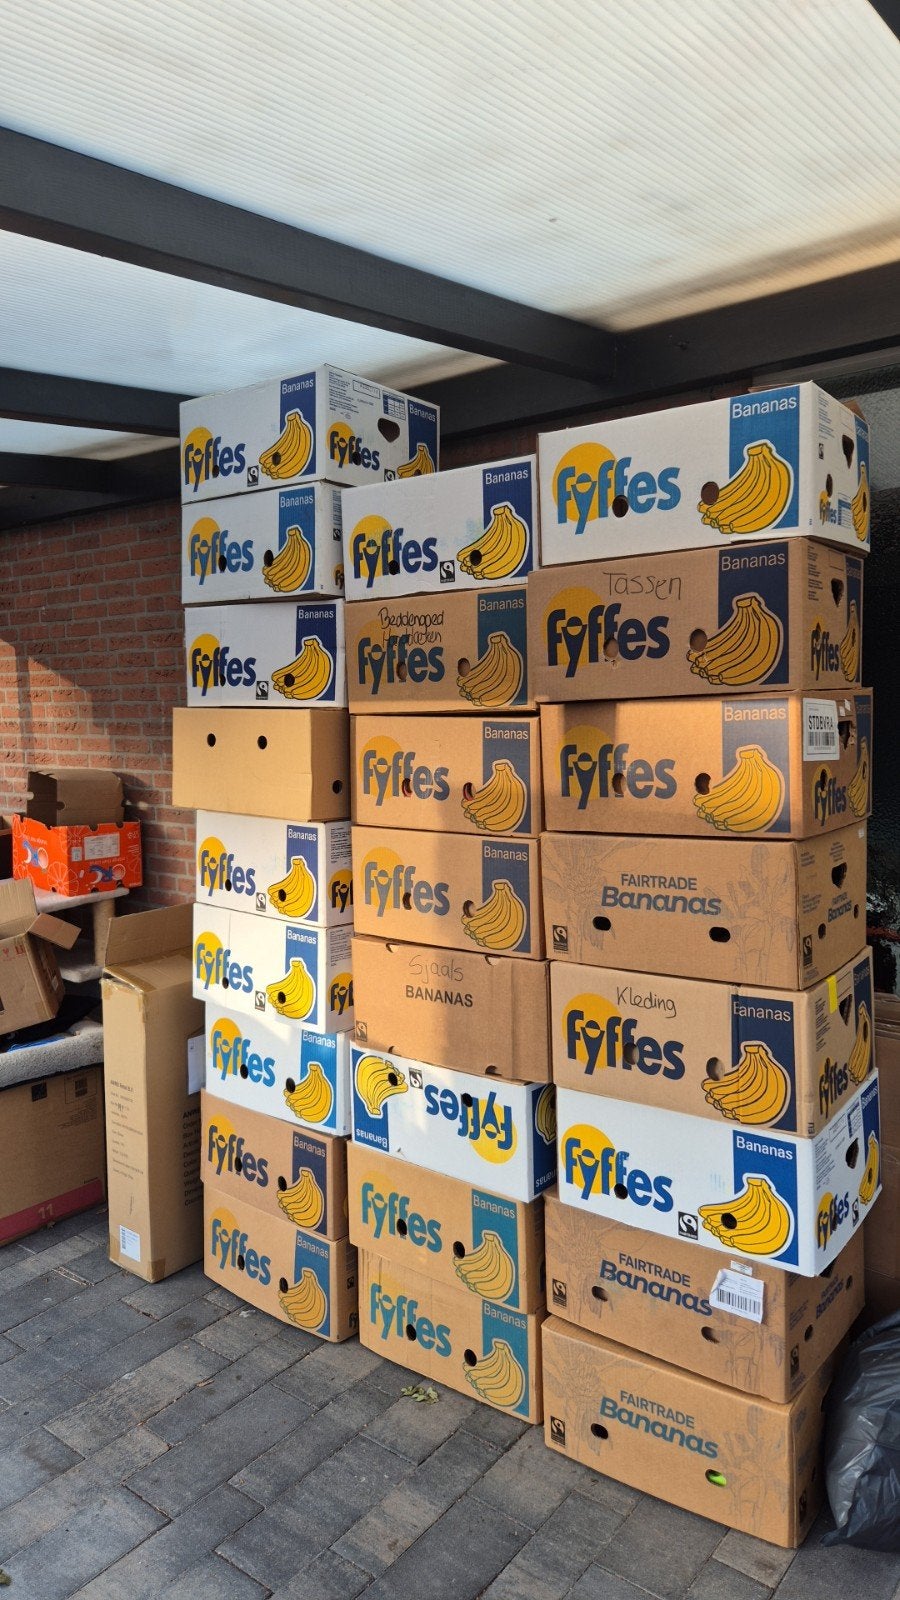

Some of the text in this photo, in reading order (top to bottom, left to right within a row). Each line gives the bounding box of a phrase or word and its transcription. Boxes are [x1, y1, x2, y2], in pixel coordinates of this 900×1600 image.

[282, 379, 314, 394] Bananas
[409, 404, 437, 422] Bananas
[731, 396, 797, 419] Bananas
[485, 469, 529, 485] Bananas
[280, 493, 314, 508] Bananas
[721, 552, 786, 571] Bananas
[603, 571, 682, 600] Tassen
[298, 609, 334, 619] Bananas
[479, 597, 524, 612] Bananas
[724, 706, 787, 722] Bananas
[484, 727, 528, 740] Bananas
[288, 829, 317, 842] Bananas
[483, 846, 528, 861] Bananas
[620, 873, 698, 891] FAIRTRADE
[600, 886, 722, 916] Bananas
[287, 929, 317, 944] Bananas
[408, 954, 464, 984] Sjaals
[405, 985, 473, 1007] BANANAS
[616, 986, 676, 1018] Kleding
[303, 1031, 336, 1048] Bananas
[294, 1136, 326, 1158] Bananas
[355, 1128, 388, 1148] Bananas
[736, 1135, 794, 1161] Bananas
[535, 1169, 557, 1188] nanas
[473, 1195, 516, 1219] Bananas
[297, 1235, 329, 1259] Bananas
[618, 1252, 691, 1288] FAIRTRADE
[599, 1259, 713, 1317] Bananas
[483, 1303, 527, 1330] Bananas
[619, 1390, 695, 1430] FAIRTRADE
[599, 1395, 719, 1460] Bananas
